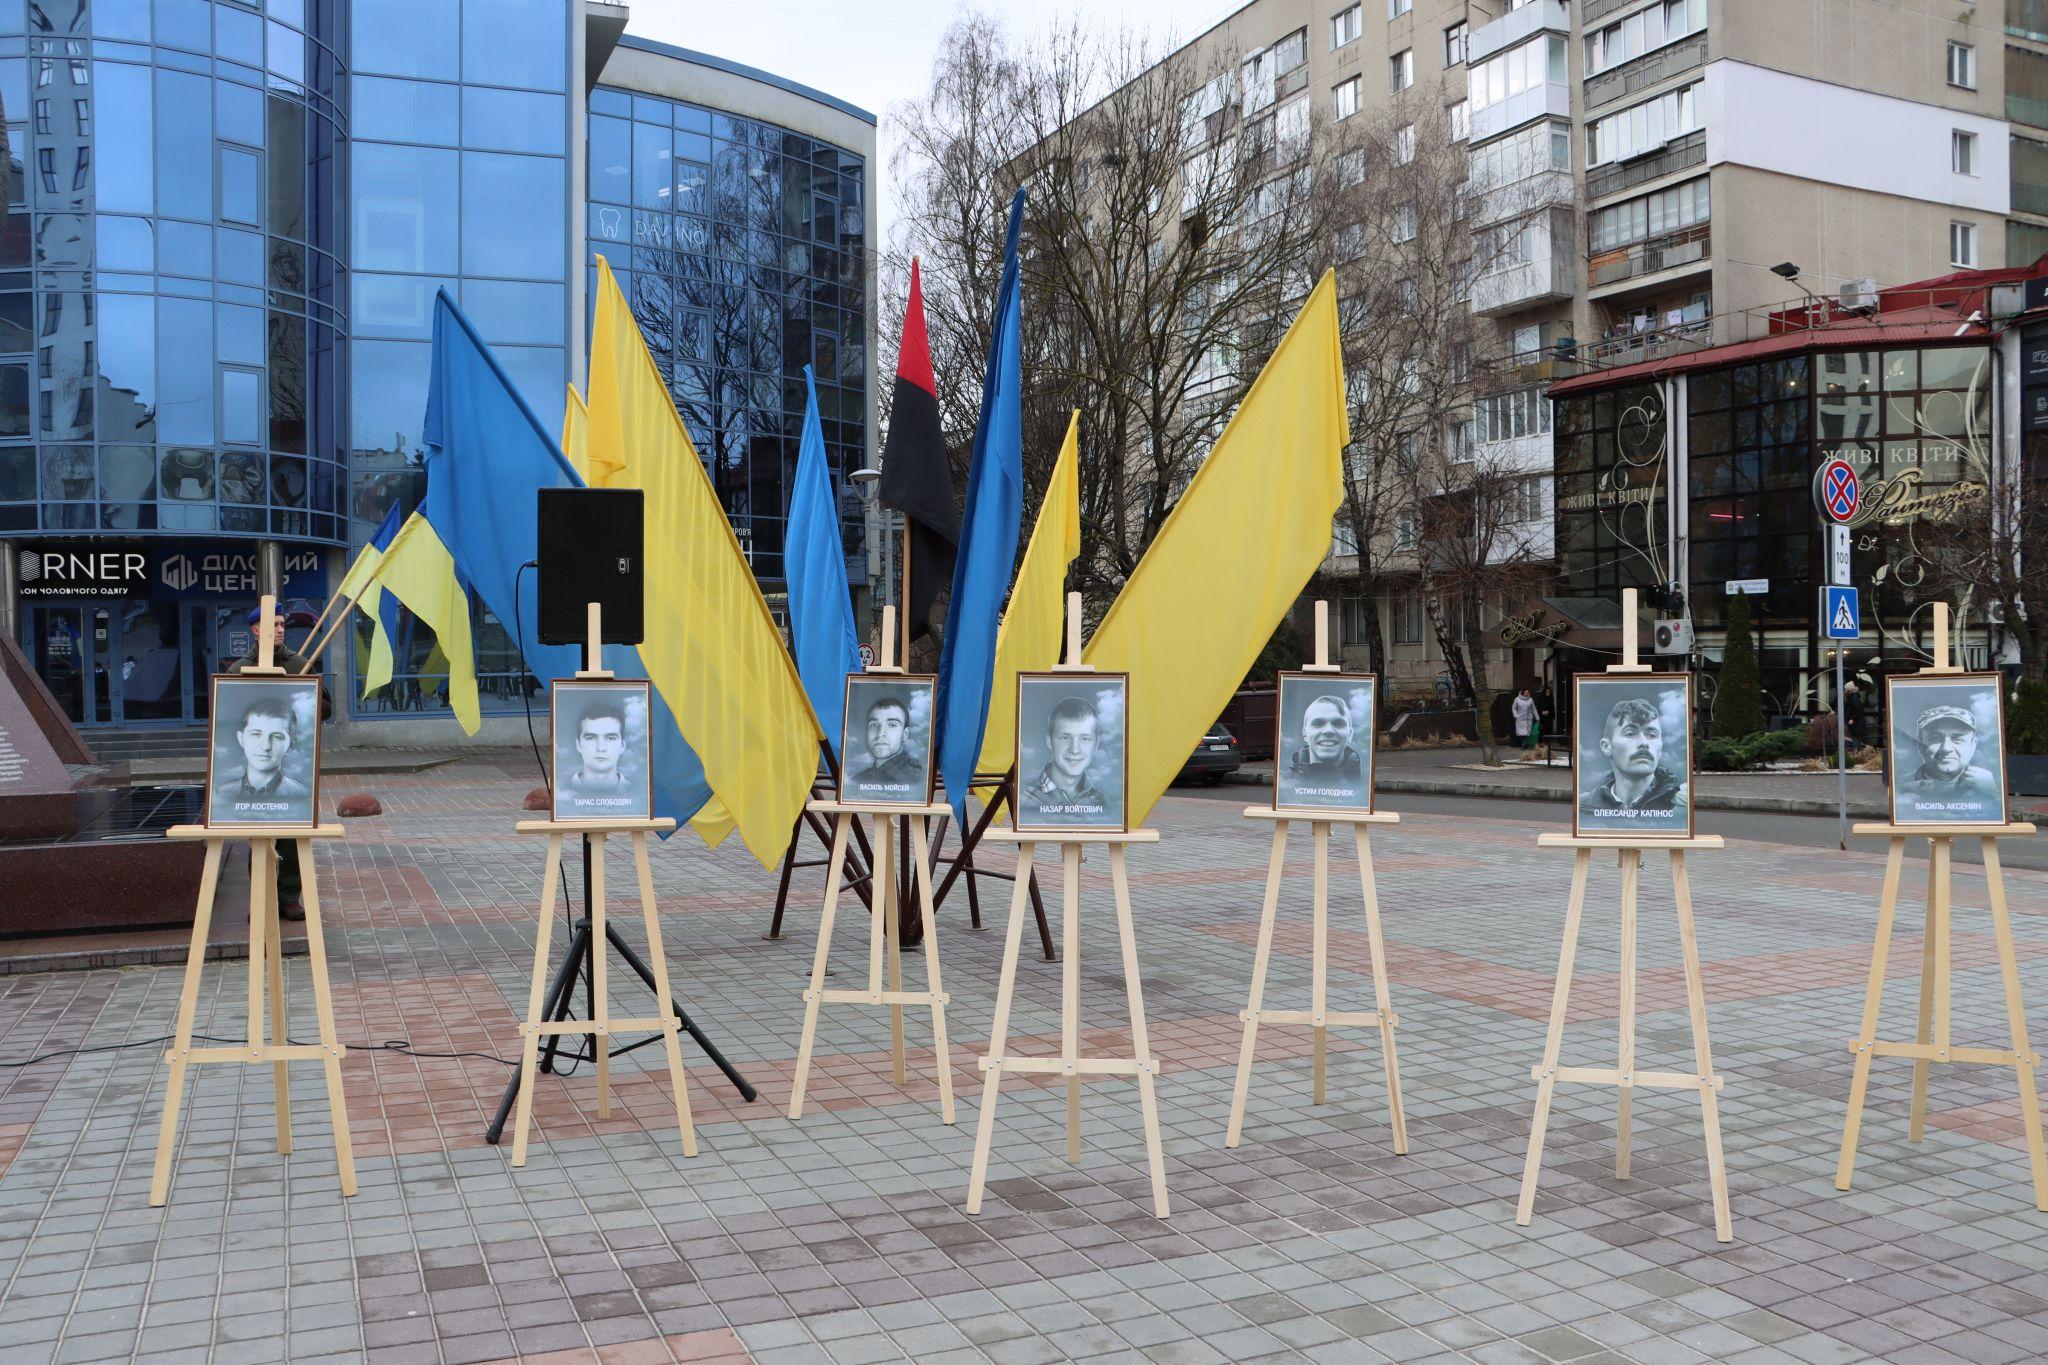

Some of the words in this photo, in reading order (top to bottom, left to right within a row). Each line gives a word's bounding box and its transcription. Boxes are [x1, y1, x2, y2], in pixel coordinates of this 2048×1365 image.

[1823, 448, 1879, 465] ЖИВІ
[1891, 446, 1959, 463] КВІТИ
[1566, 493, 1600, 509] ЖИВІ
[1608, 487, 1649, 505] КВІТИ
[202, 551, 318, 571] ДІЛИЙ
[1836, 551, 1849, 566] 100
[204, 574, 290, 593] ЦЕН
[39, 587, 97, 595] ЧОЛОВІЧОГО
[100, 587, 128, 595] ОДЯГУ
[1294, 787, 1317, 795] УСТИМ
[235, 802, 250, 811] ІГОР
[251, 802, 289, 811] КОСТЕНКО
[574, 798, 595, 806] ТАРАС
[1915, 802, 1945, 810] ВАСИЛЬ
[1946, 802, 1982, 810] АКСЕНИН
[1040, 805, 1063, 813] НАЗАР
[1064, 804, 1103, 813] ВОЙТОВИЧ
[1594, 809, 1639, 818] ОЛЕКСАНДР
[1640, 809, 1674, 818] КАПІНОС
